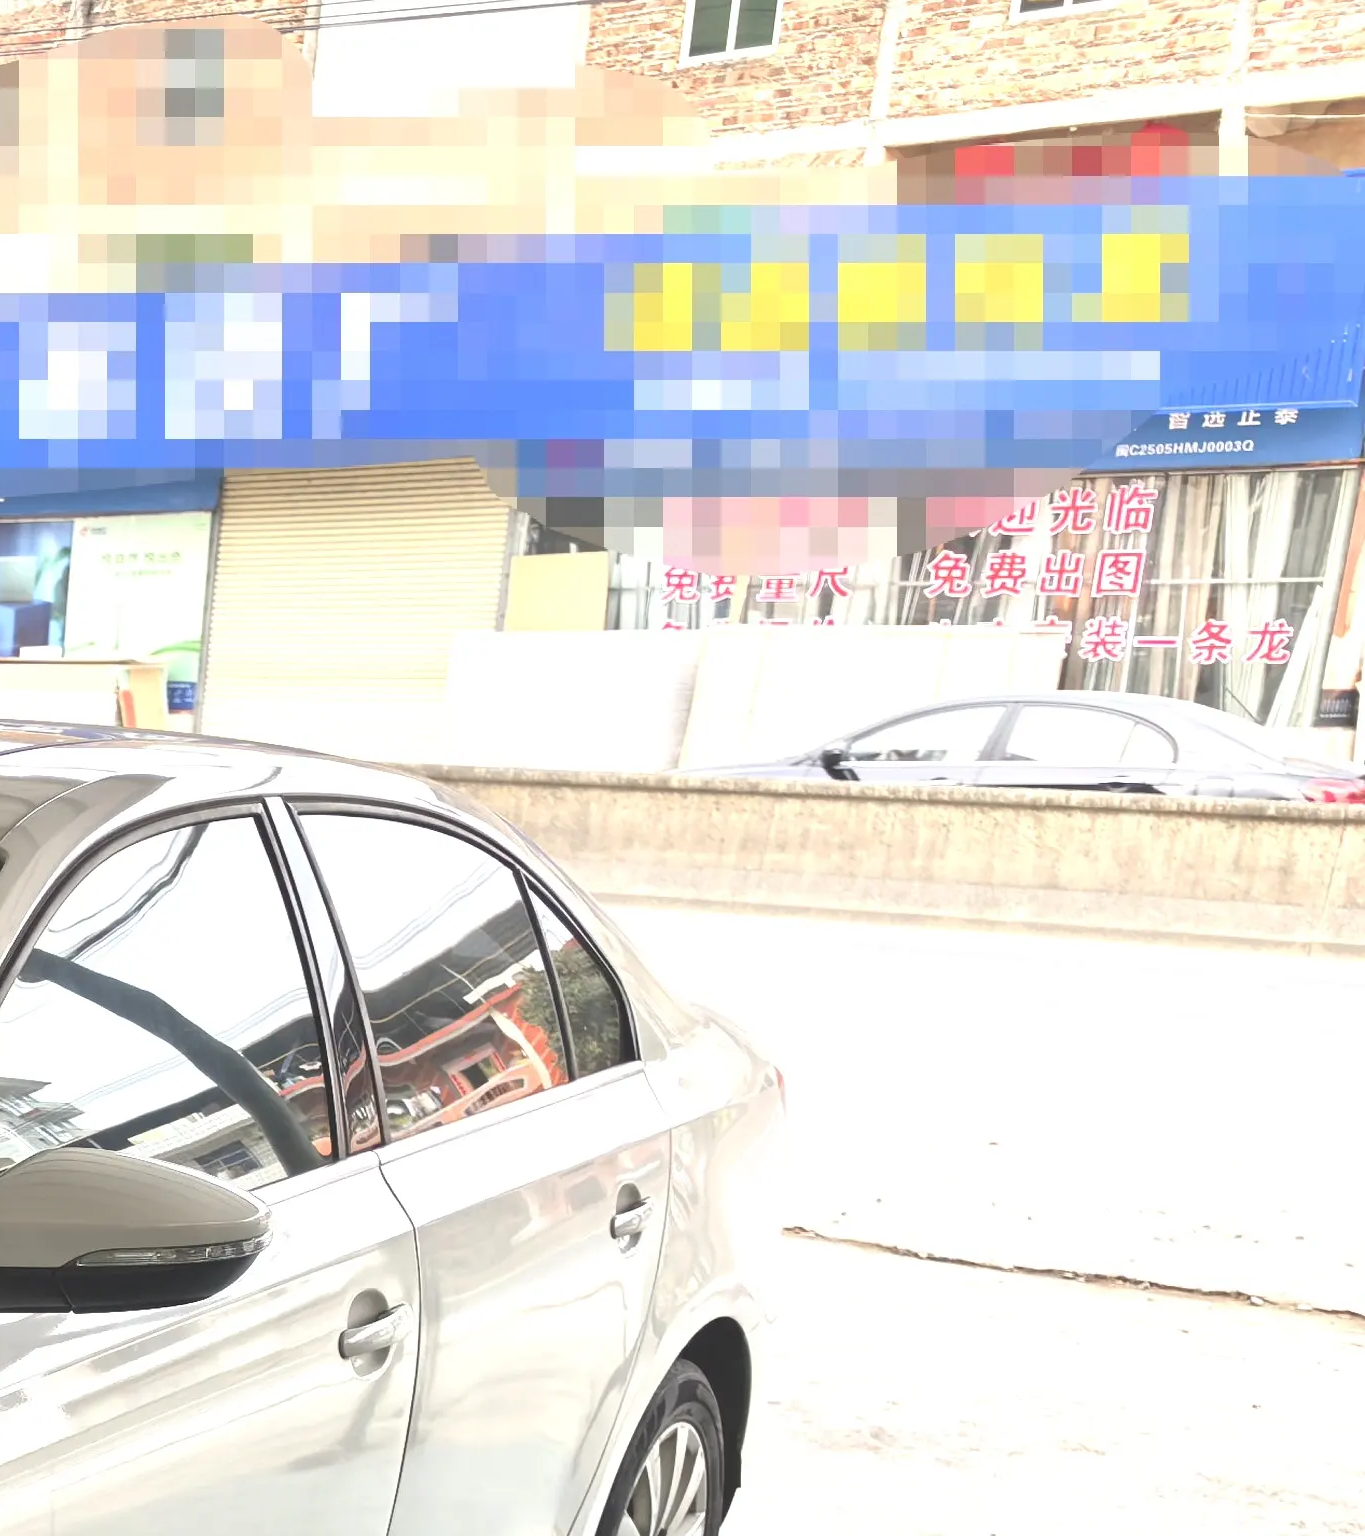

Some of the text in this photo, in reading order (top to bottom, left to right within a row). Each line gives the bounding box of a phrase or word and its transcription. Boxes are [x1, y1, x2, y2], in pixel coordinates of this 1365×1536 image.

[967, 479, 1158, 536] 迎光临
[924, 550, 1146, 599] 免费出图
